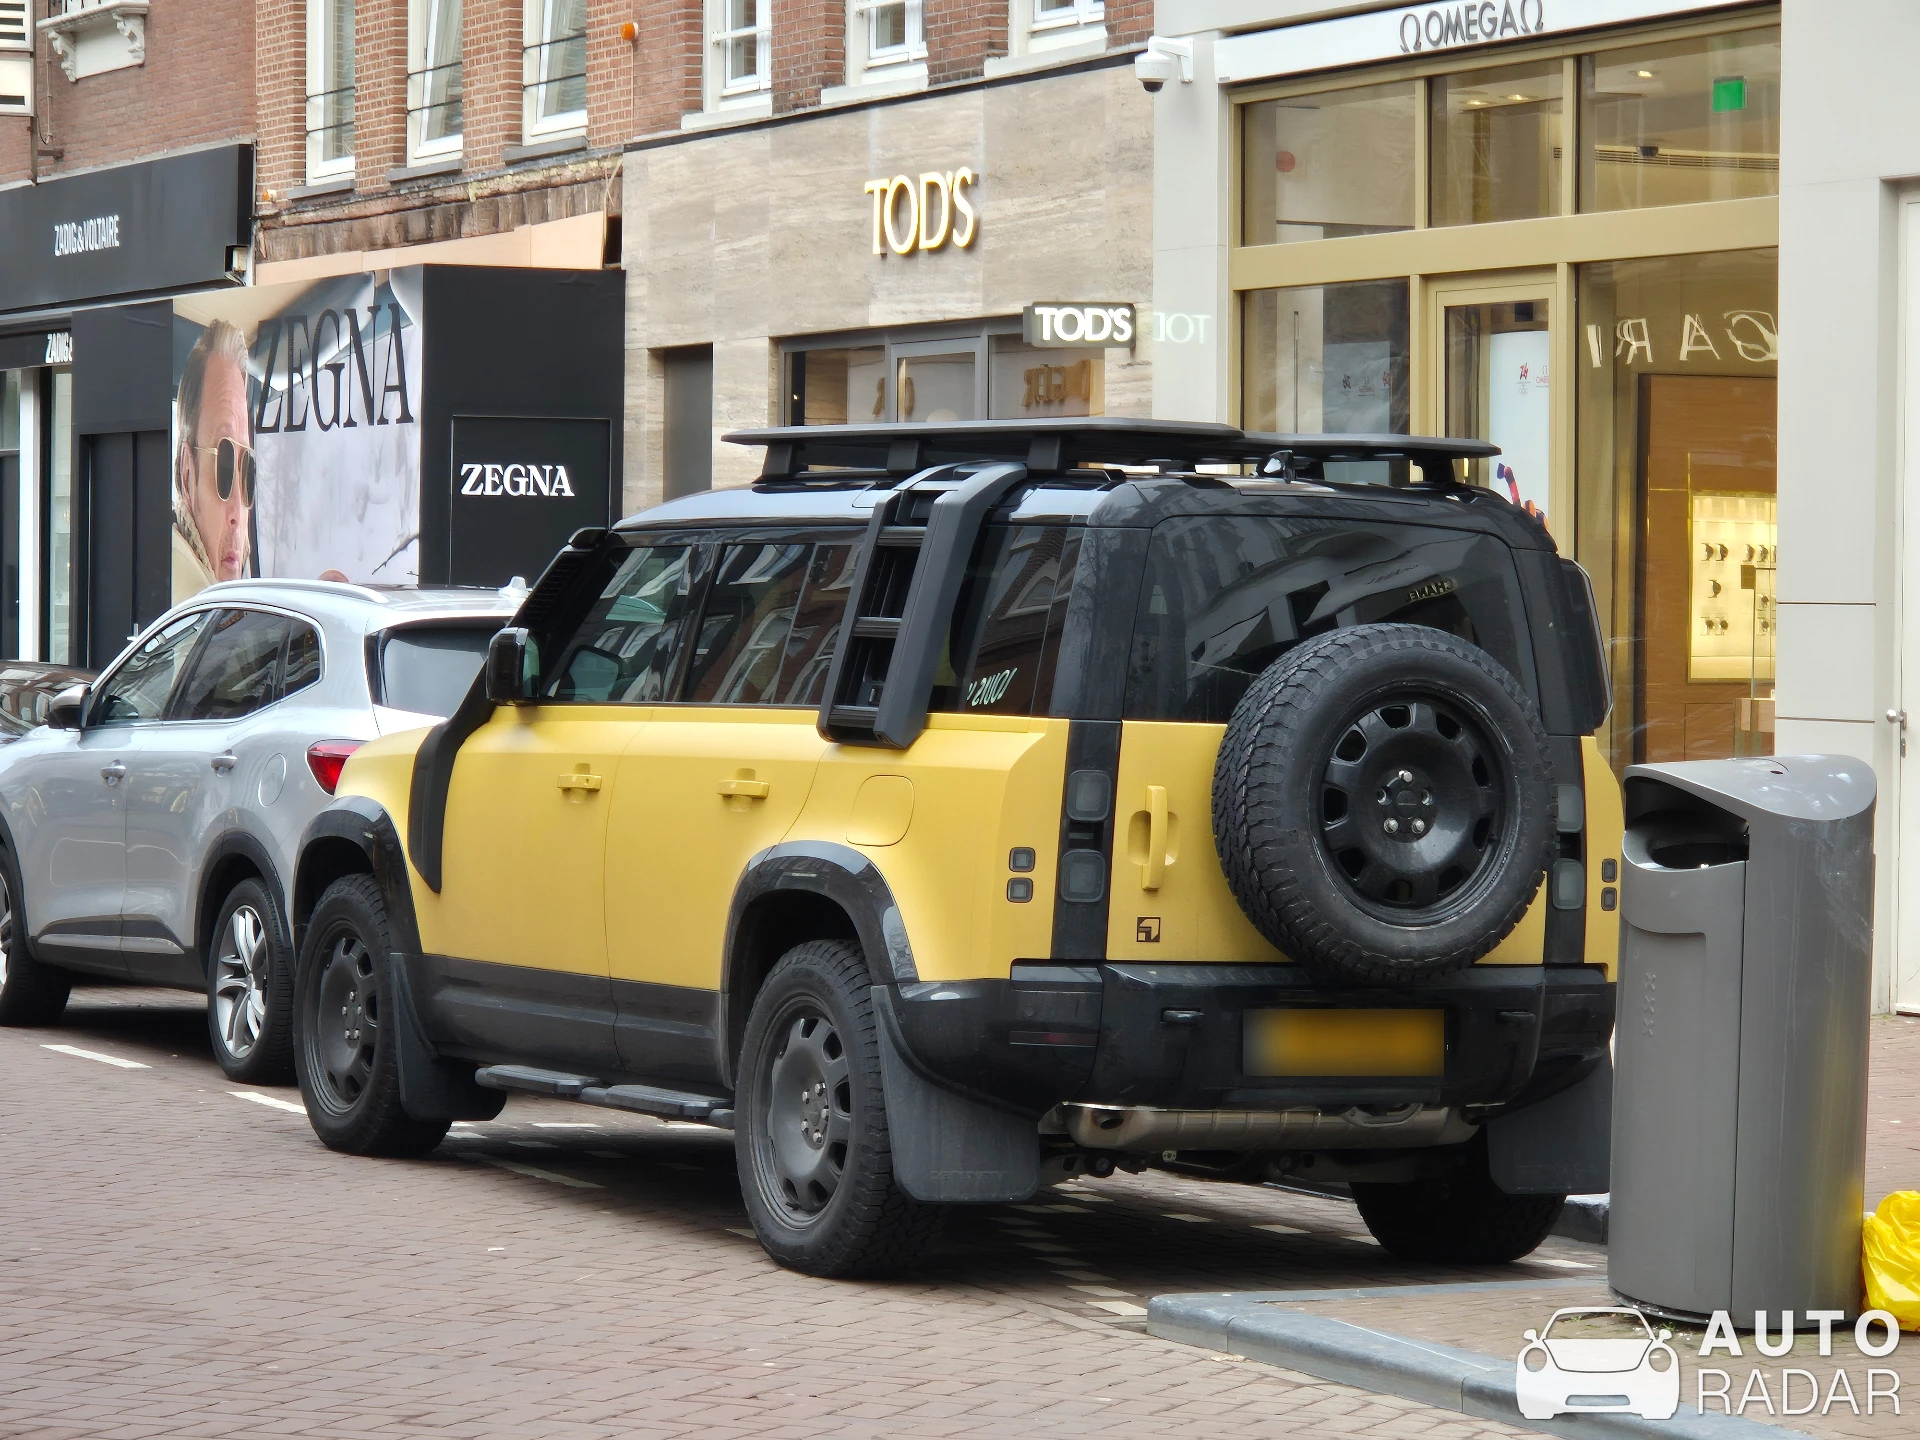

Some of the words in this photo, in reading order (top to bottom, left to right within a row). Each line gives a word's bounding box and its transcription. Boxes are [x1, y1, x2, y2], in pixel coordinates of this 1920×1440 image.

[1424, 0, 1519, 46] OMEGA
[864, 166, 975, 256] TOD'S
[1034, 307, 1133, 343] TOD'S
[255, 303, 414, 434] ZEGNA
[460, 463, 576, 497] ZEGNA
